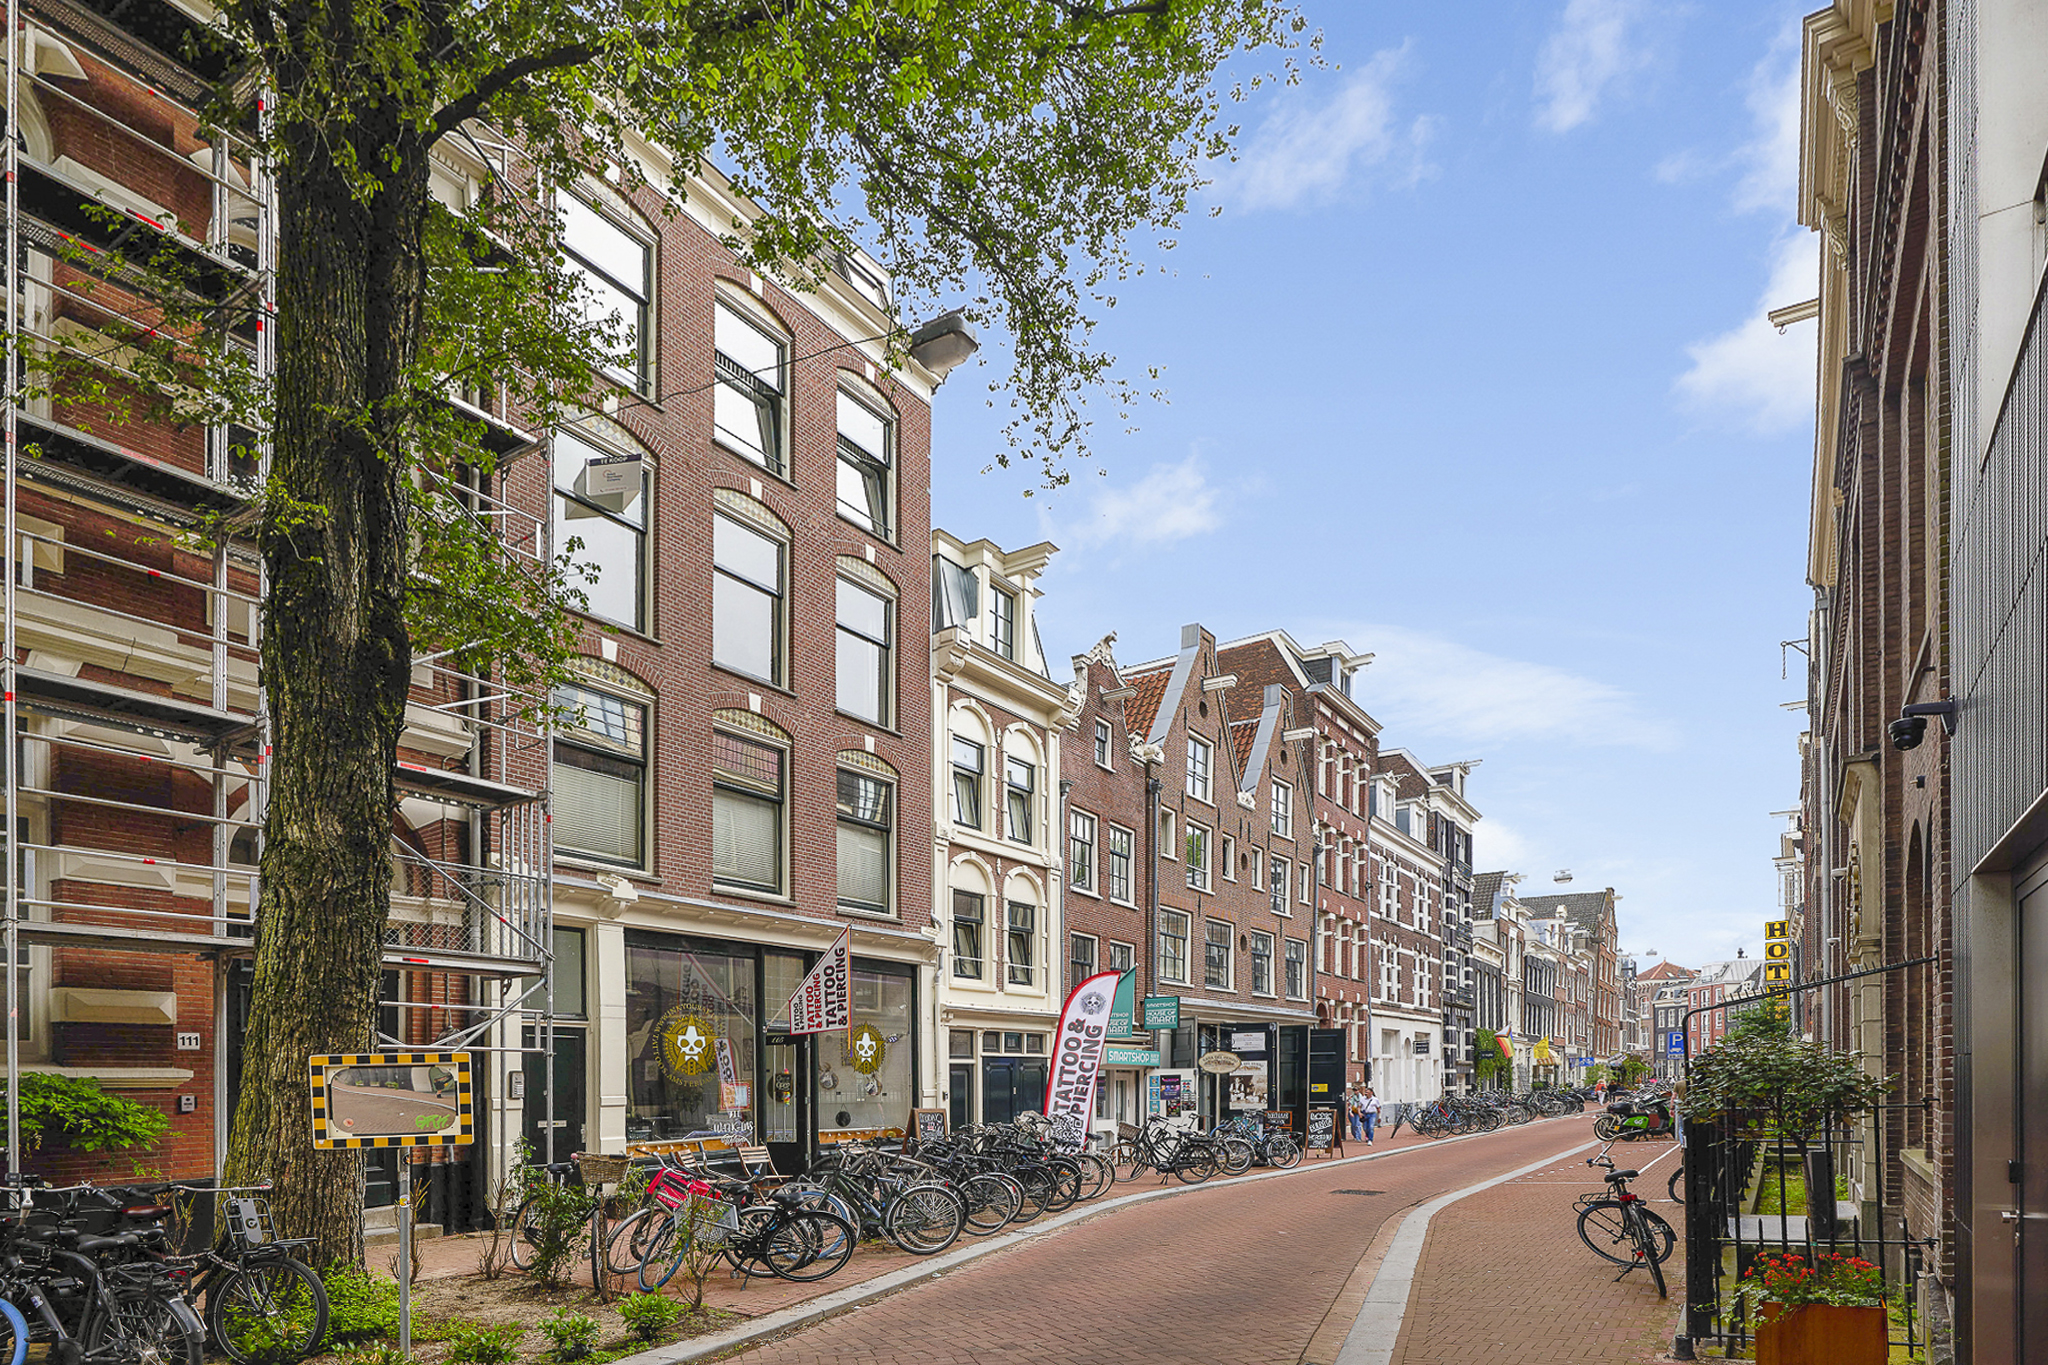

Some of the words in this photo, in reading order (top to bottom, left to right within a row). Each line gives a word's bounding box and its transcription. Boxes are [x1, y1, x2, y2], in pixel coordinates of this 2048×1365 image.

[834, 947, 847, 1012] PIERCING
[812, 973, 822, 1019] PIERCING
[823, 965, 837, 1028] TATTOO
[805, 985, 815, 1030] TATTOO
[815, 1020, 822, 1029] &
[838, 1015, 847, 1026] &
[1067, 1018, 1086, 1034] &
[1146, 1015, 1176, 1024] SMART
[179, 1036, 199, 1046] 111
[1672, 1034, 1683, 1046] P
[1108, 1050, 1150, 1063] SMARTSHOP
[1053, 1037, 1082, 1112] TATTOO
[1070, 1025, 1103, 1115] PIERCING
